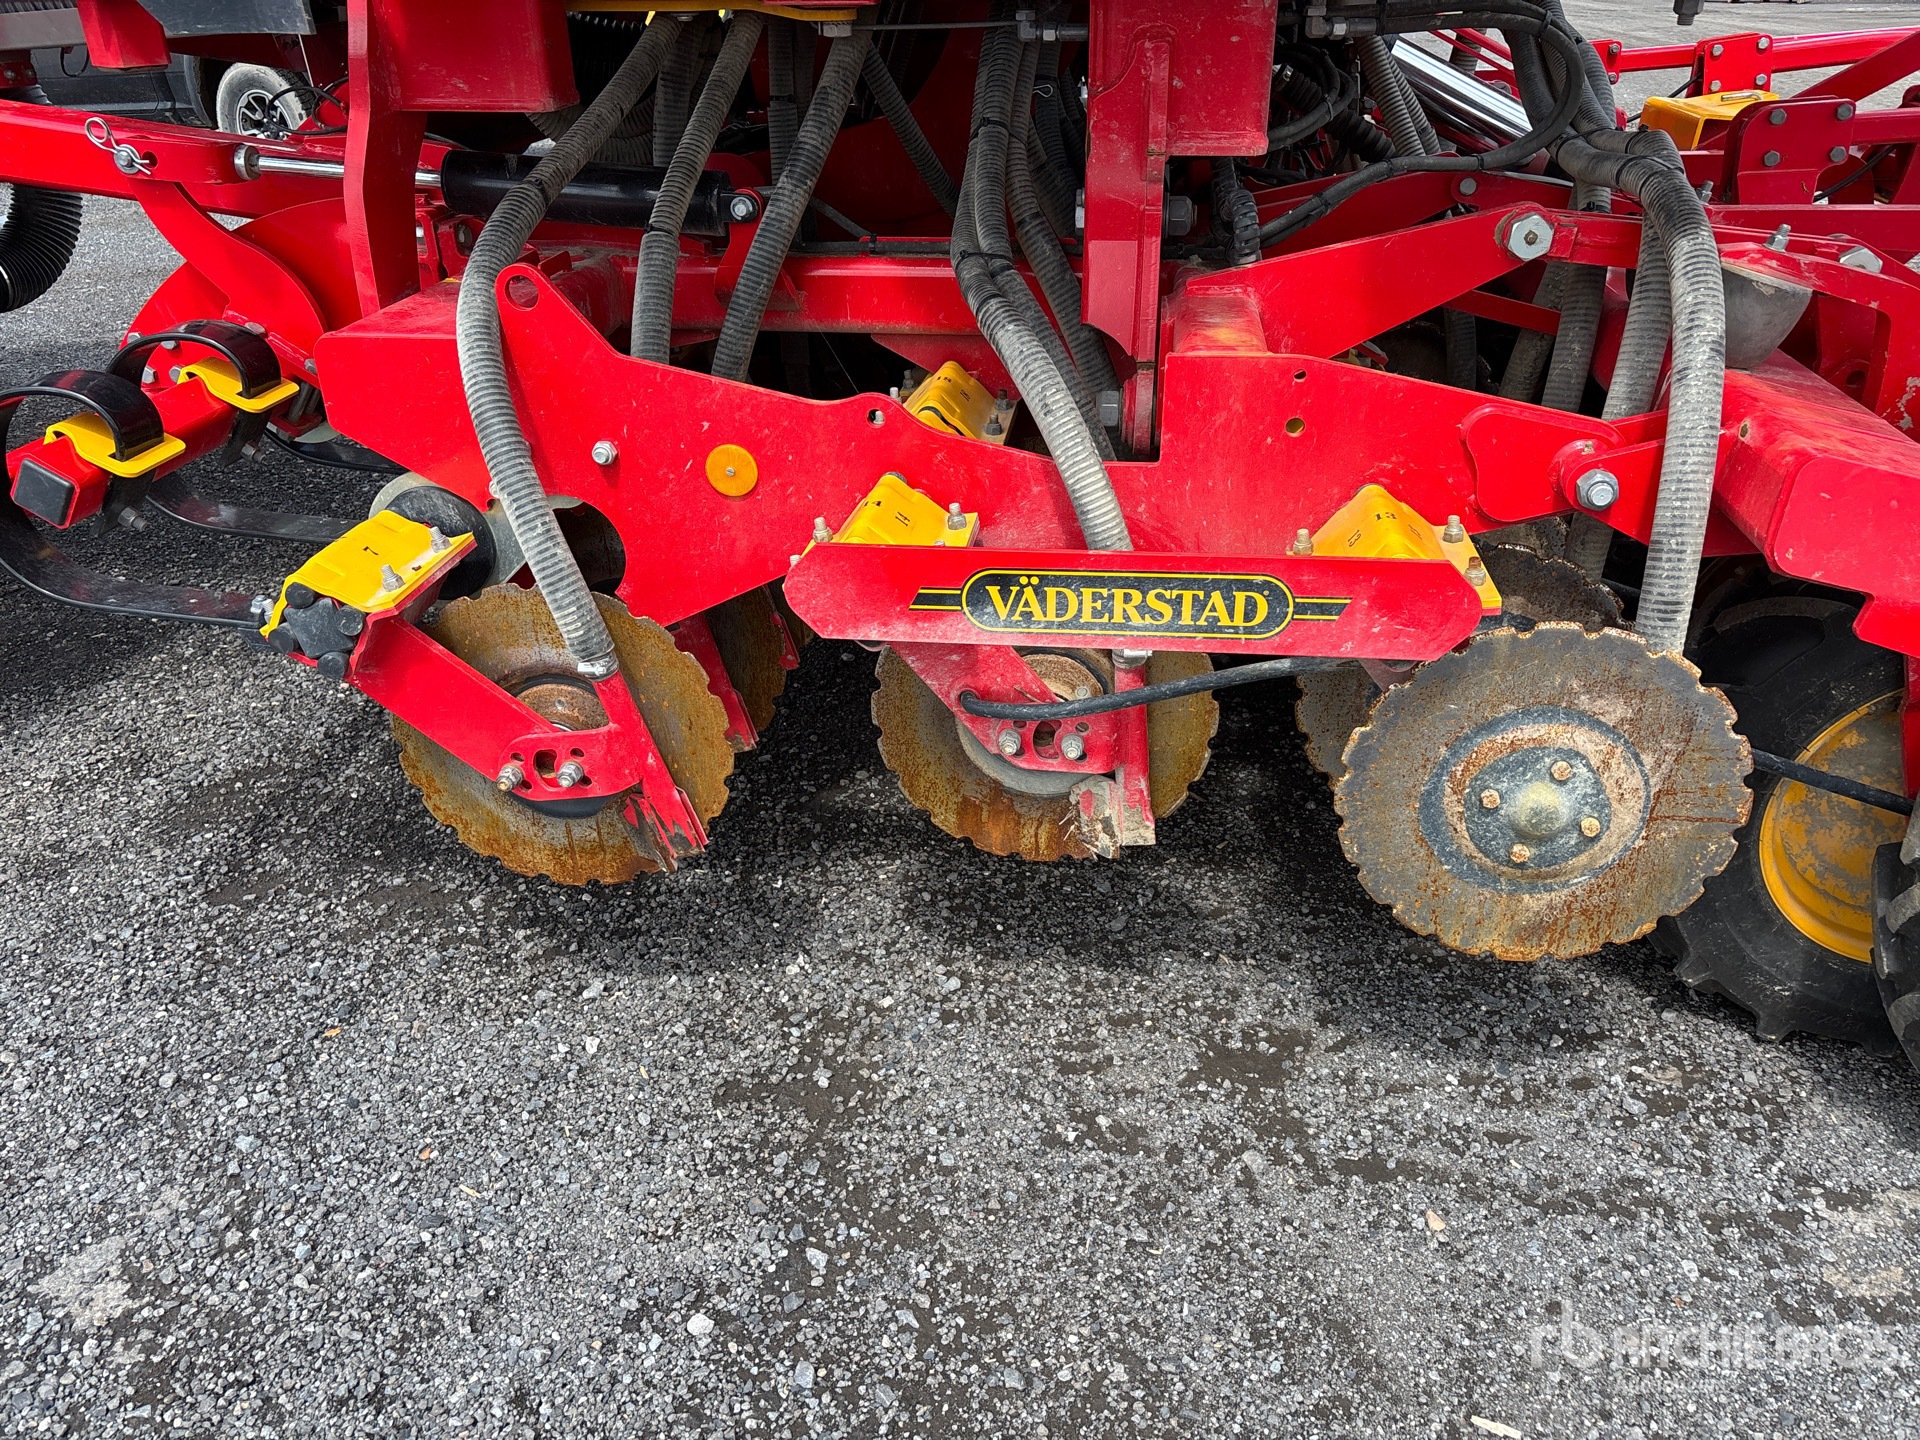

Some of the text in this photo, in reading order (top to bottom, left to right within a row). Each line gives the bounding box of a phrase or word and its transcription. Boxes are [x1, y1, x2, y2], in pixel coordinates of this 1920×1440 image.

[1373, 511, 1397, 521] 13
[1347, 529, 1362, 548] 13
[985, 576, 1265, 627] VÄDERSTAD
